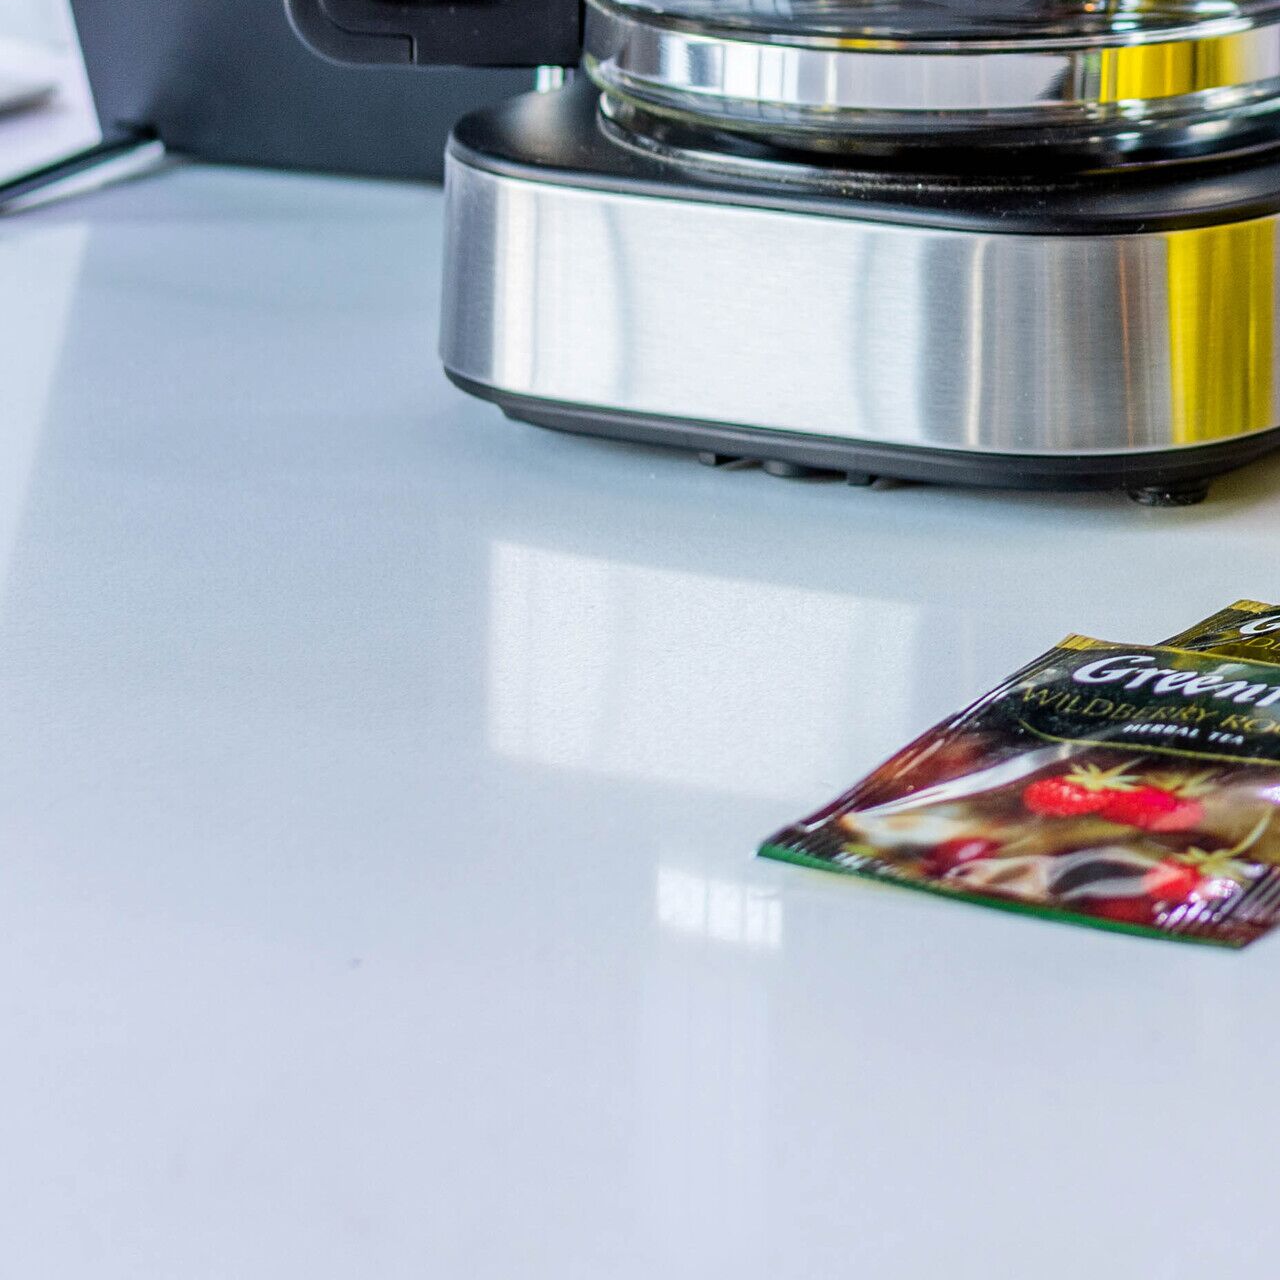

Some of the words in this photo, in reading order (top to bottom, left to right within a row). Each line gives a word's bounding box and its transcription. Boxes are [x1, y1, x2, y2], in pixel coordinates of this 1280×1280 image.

[1020, 687, 1218, 722] WILDBERRY
[1123, 723, 1200, 738] HERBAL
[1207, 730, 1245, 746] TEA
